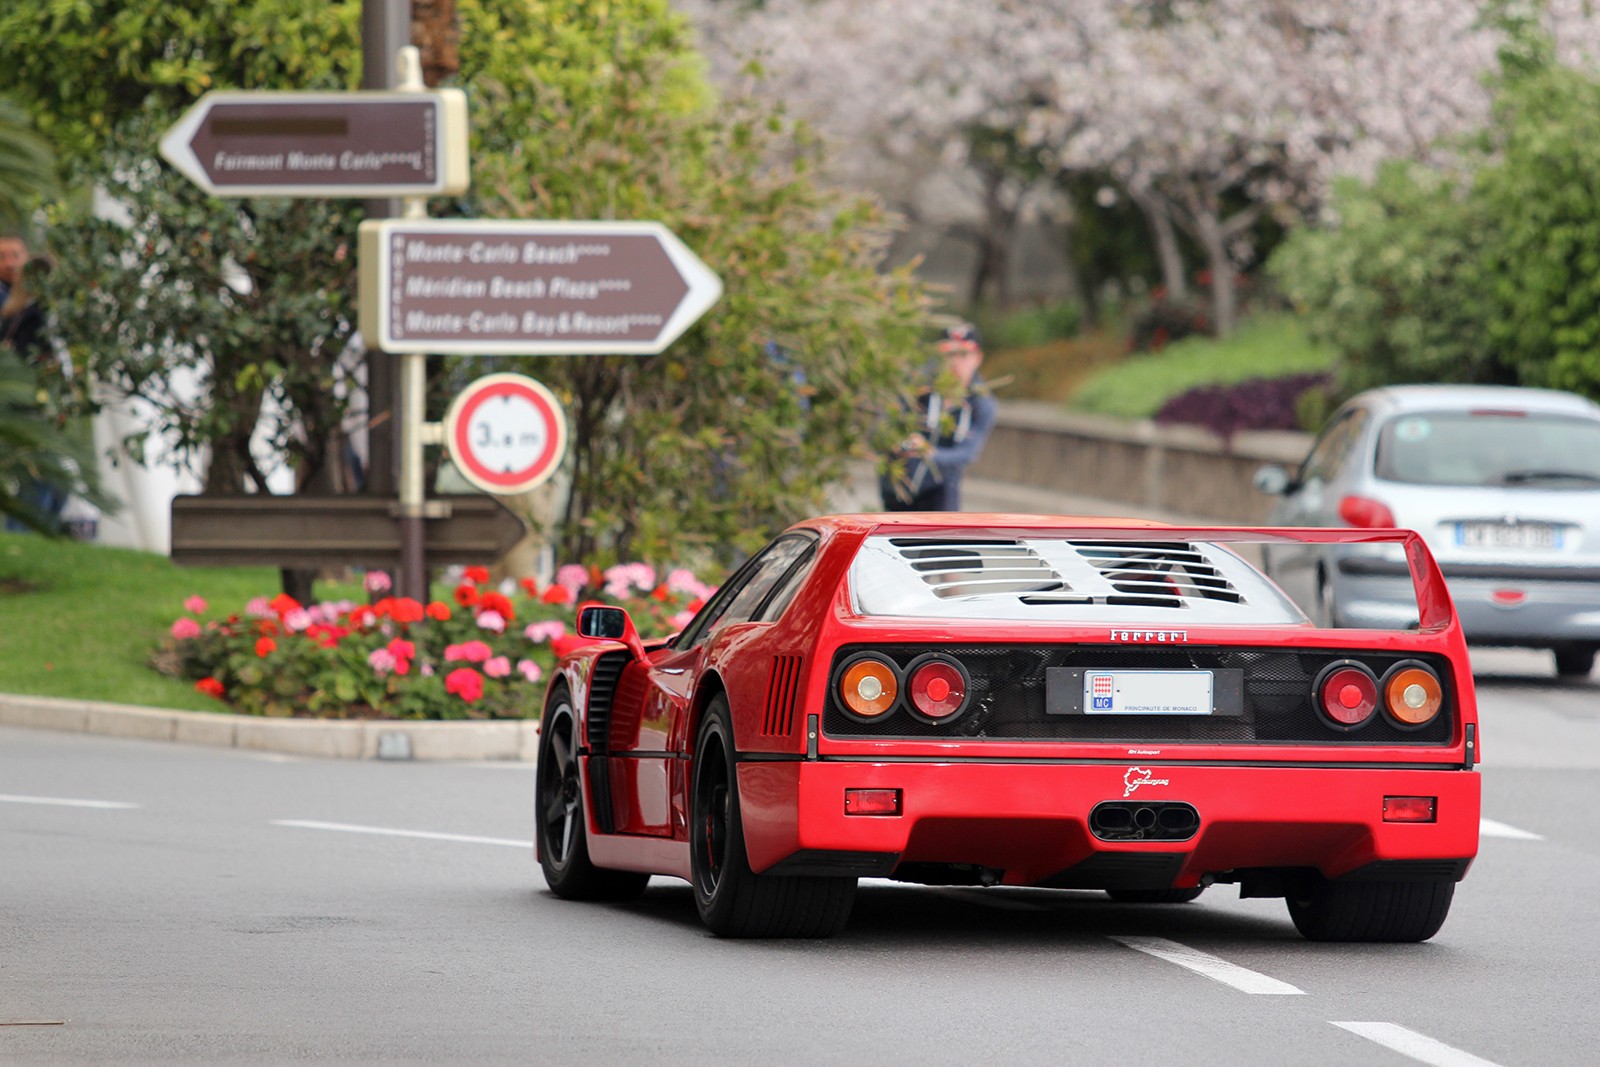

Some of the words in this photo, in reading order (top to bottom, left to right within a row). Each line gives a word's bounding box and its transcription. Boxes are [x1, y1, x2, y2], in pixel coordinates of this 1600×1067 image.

[287, 151, 336, 171] Monte
[340, 151, 382, 171] Carlo
[406, 240, 518, 264] Monte-Carlo
[522, 240, 579, 264] Beach
[490, 276, 546, 298] Beach
[550, 276, 600, 299] Plaza
[406, 311, 518, 334] Monte-Carlo
[1110, 629, 1188, 642] Ferrari
[1096, 698, 1109, 708] MC
